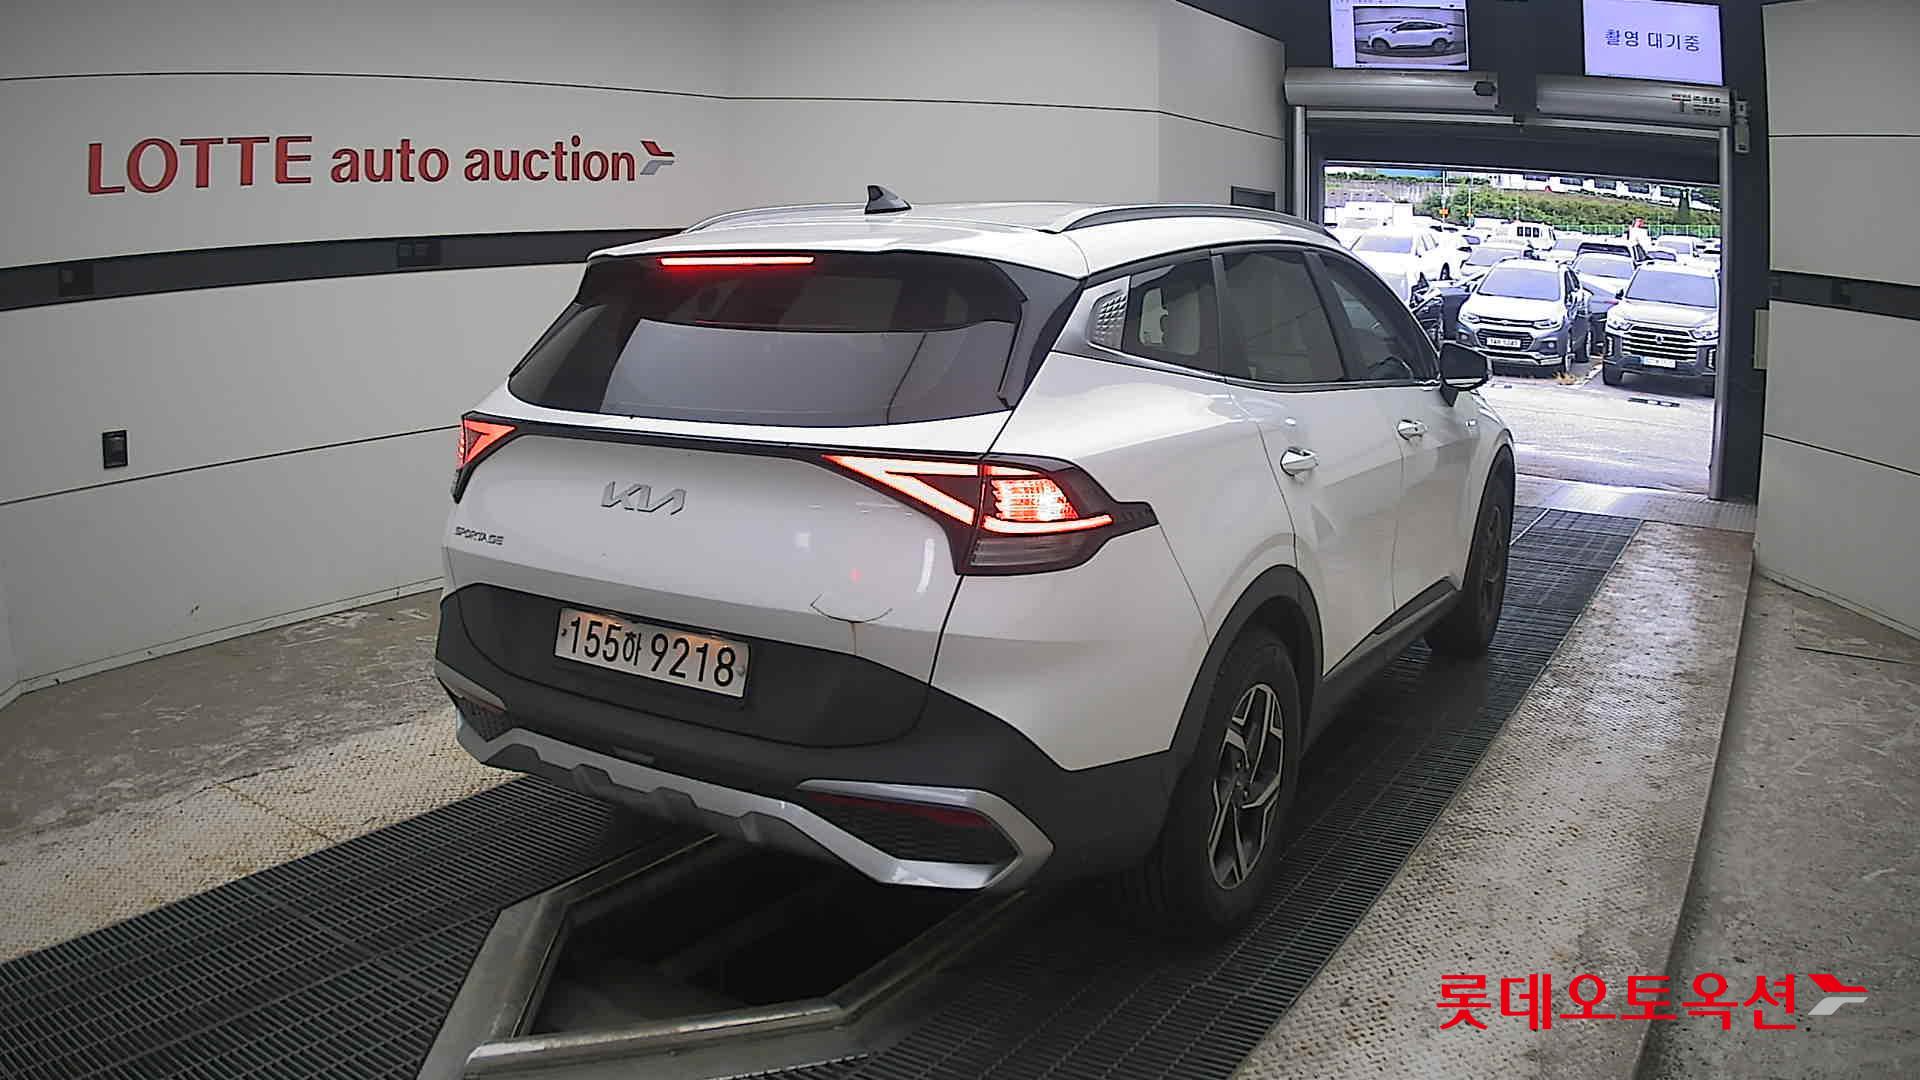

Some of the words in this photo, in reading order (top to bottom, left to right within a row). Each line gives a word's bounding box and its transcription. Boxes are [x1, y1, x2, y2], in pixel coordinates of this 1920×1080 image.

[1647, 32, 1700, 52] 대기중
[88, 135, 313, 195] LOTTE
[330, 138, 450, 183] auto
[463, 134, 637, 182] auction
[600, 480, 687, 516] KIA
[569, 616, 643, 667] 155하
[650, 632, 737, 688] 9218
